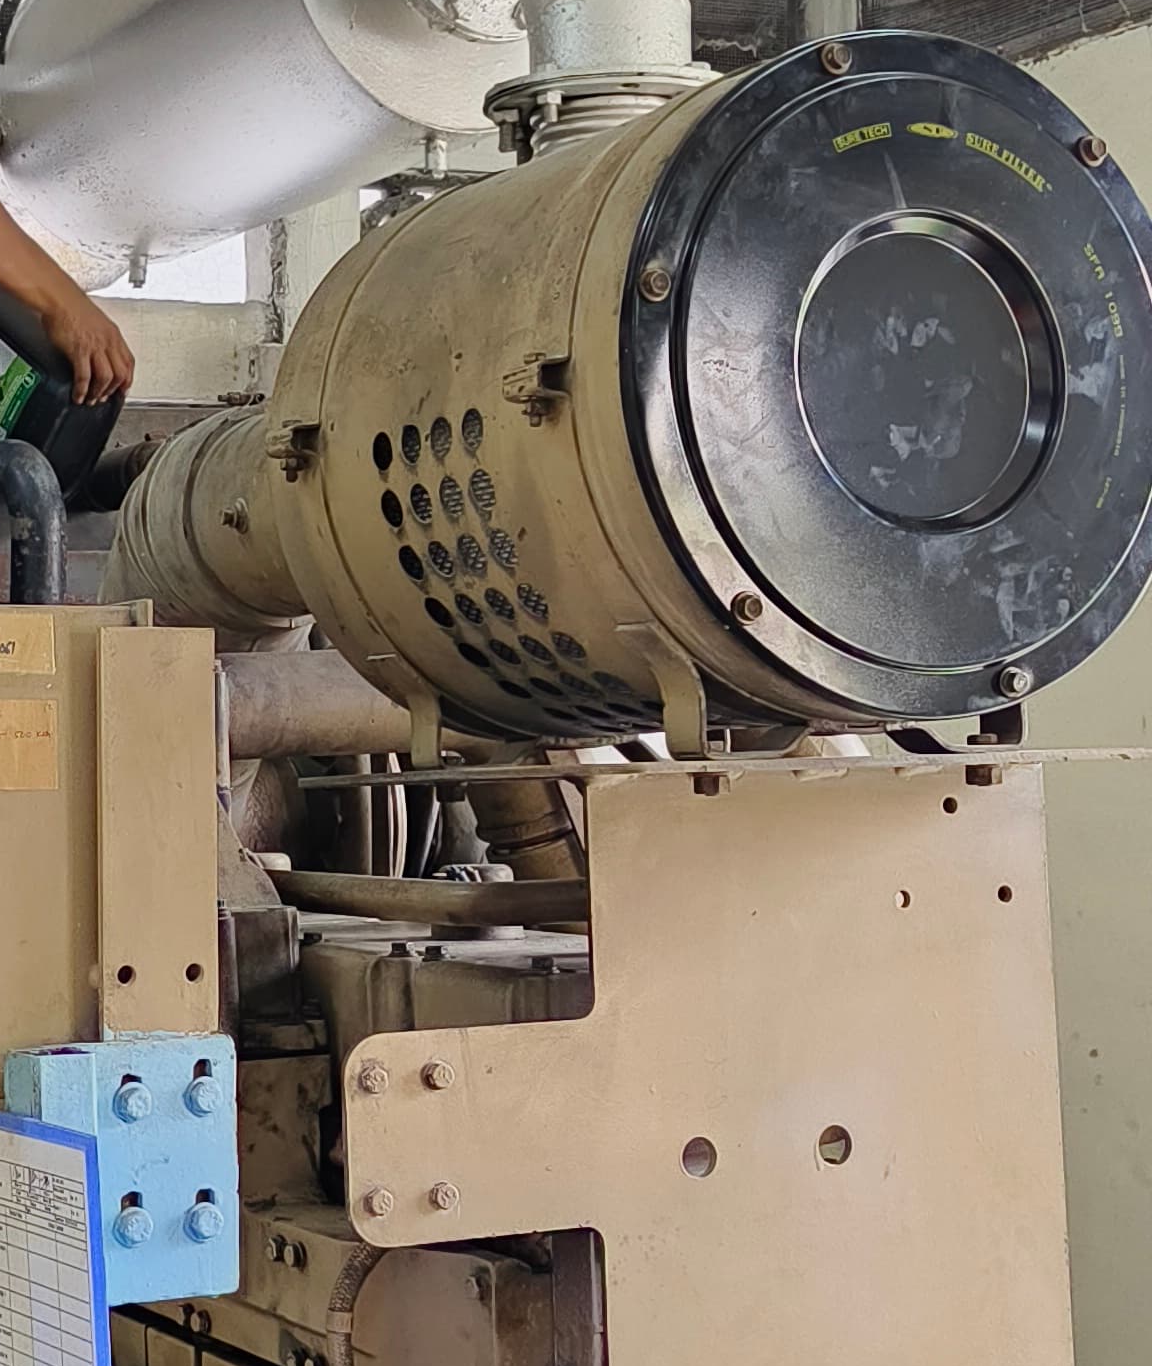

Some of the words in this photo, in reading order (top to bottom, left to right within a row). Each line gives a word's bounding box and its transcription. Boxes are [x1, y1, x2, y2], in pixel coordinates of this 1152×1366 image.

[864, 125, 888, 139] TECH
[966, 132, 1000, 157] SURE
[1002, 148, 1046, 192] FILTER
